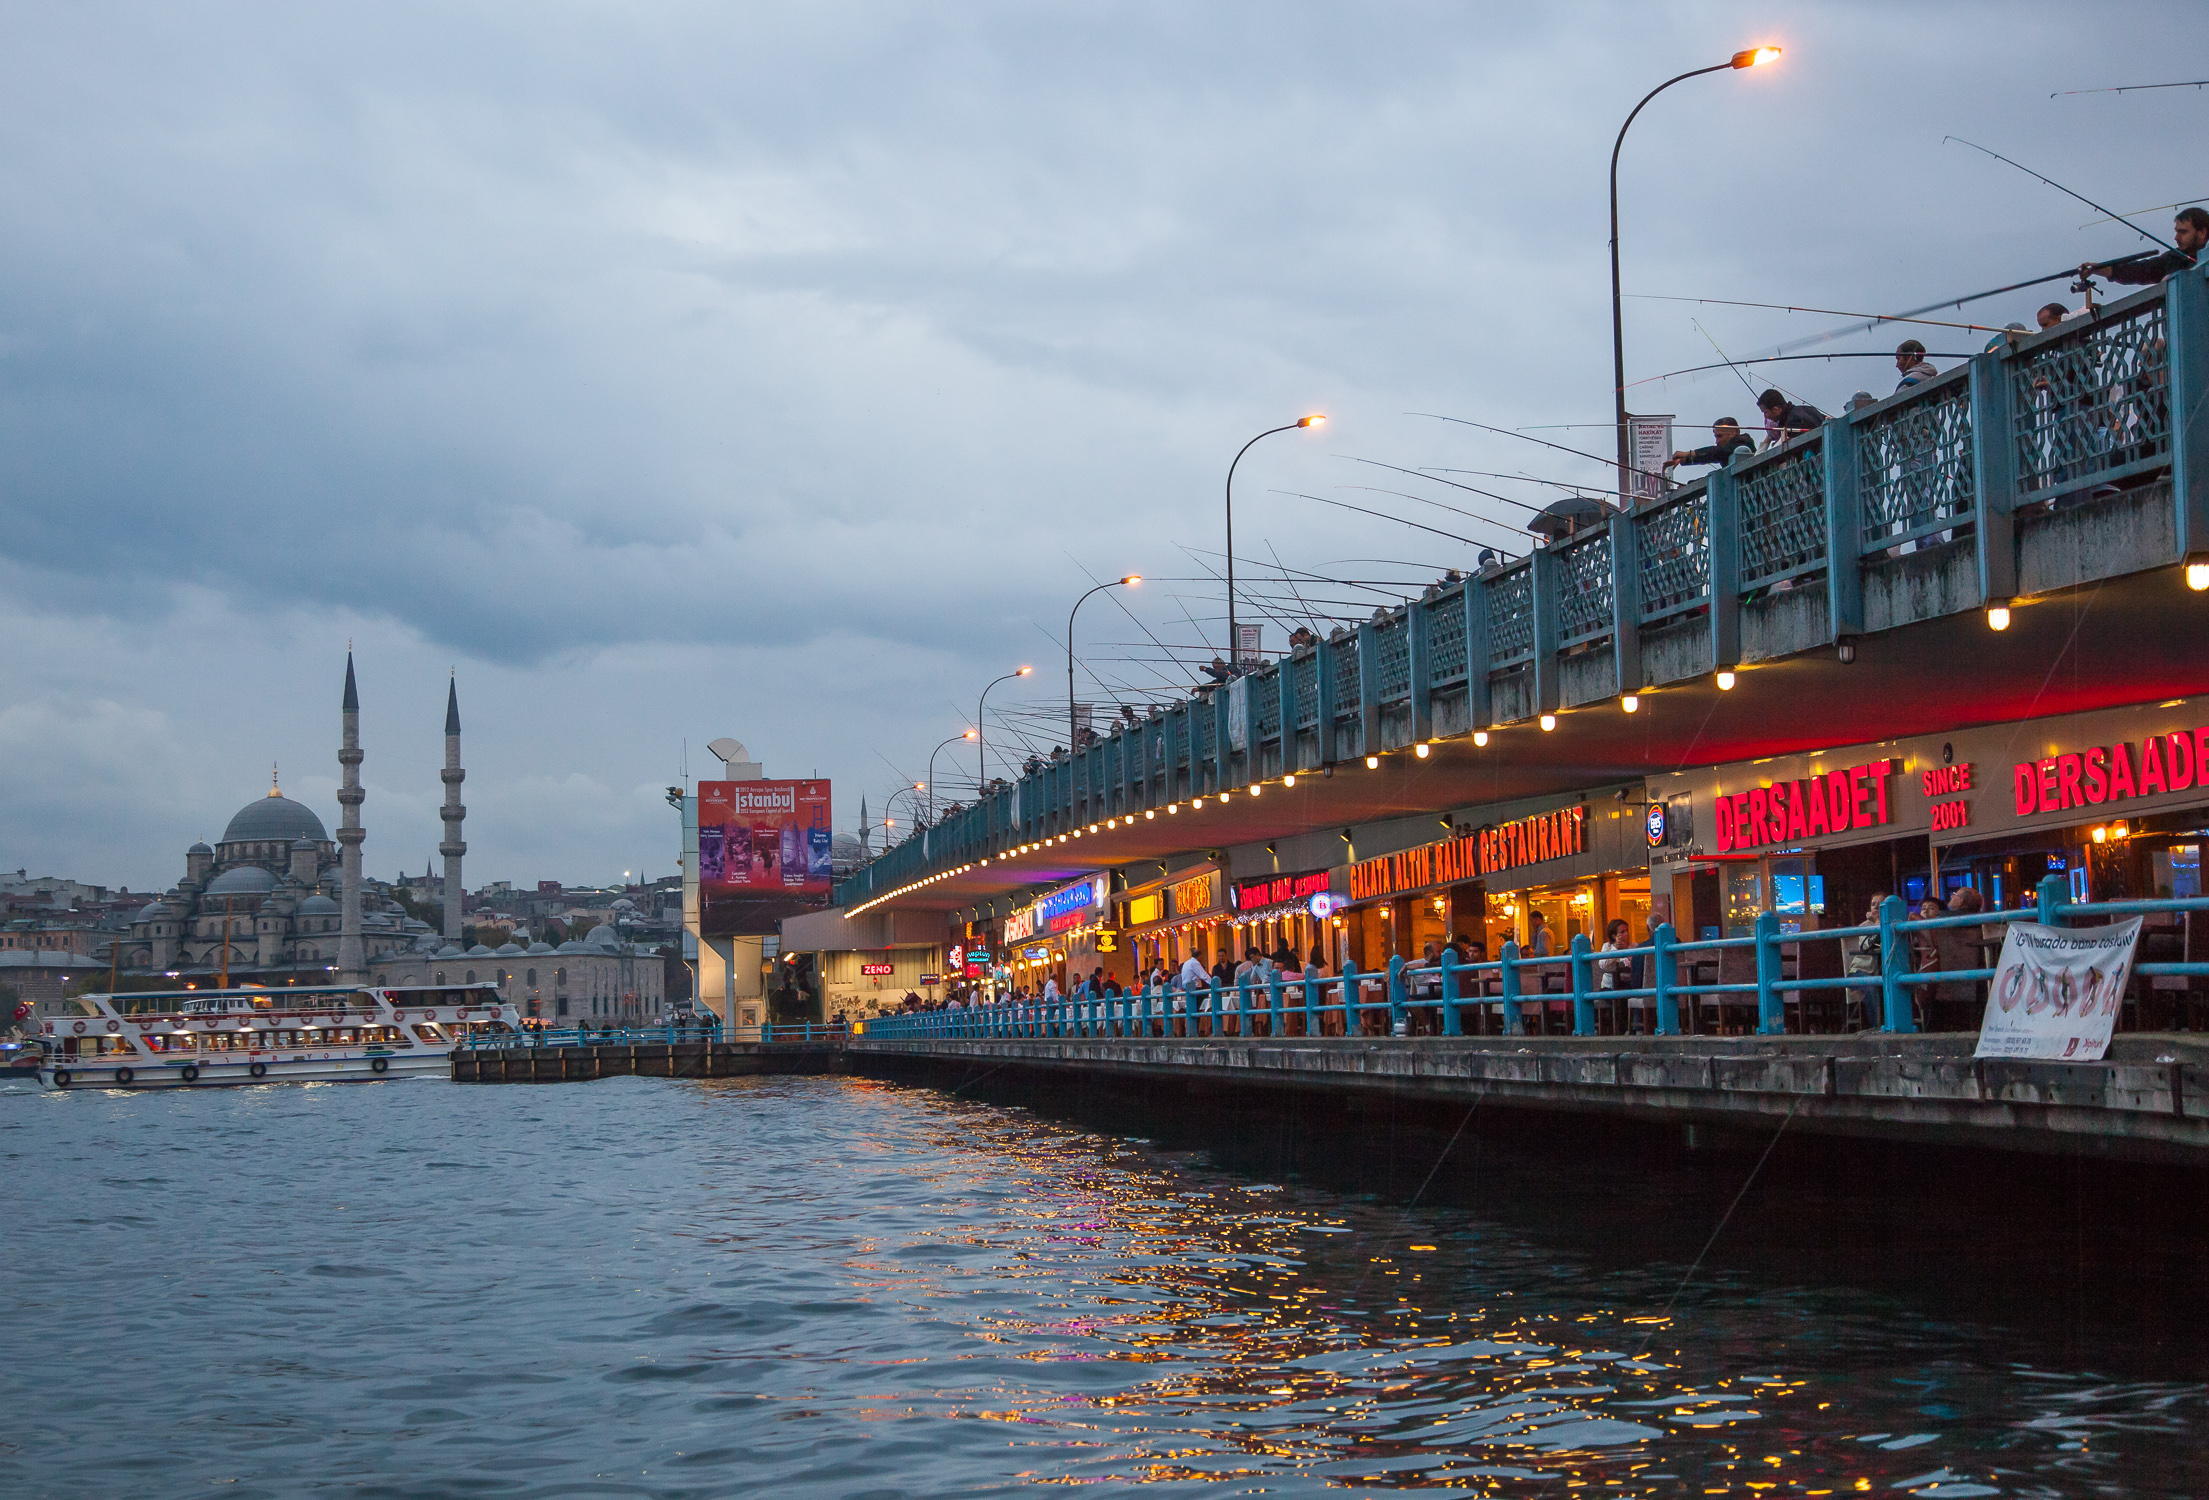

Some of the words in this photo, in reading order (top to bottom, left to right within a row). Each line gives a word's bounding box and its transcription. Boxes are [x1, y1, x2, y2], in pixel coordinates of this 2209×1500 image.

[1922, 763, 1971, 797] SINCE
[1715, 758, 1891, 852] DERSAADET
[1930, 800, 1967, 831] 2001
[1350, 857, 1392, 901] GALATA
[1395, 846, 1430, 891] ALTIN
[1435, 836, 1476, 883] BALIK
[1480, 806, 1583, 874] RESTAURANT
[864, 965, 892, 975] ZENO
